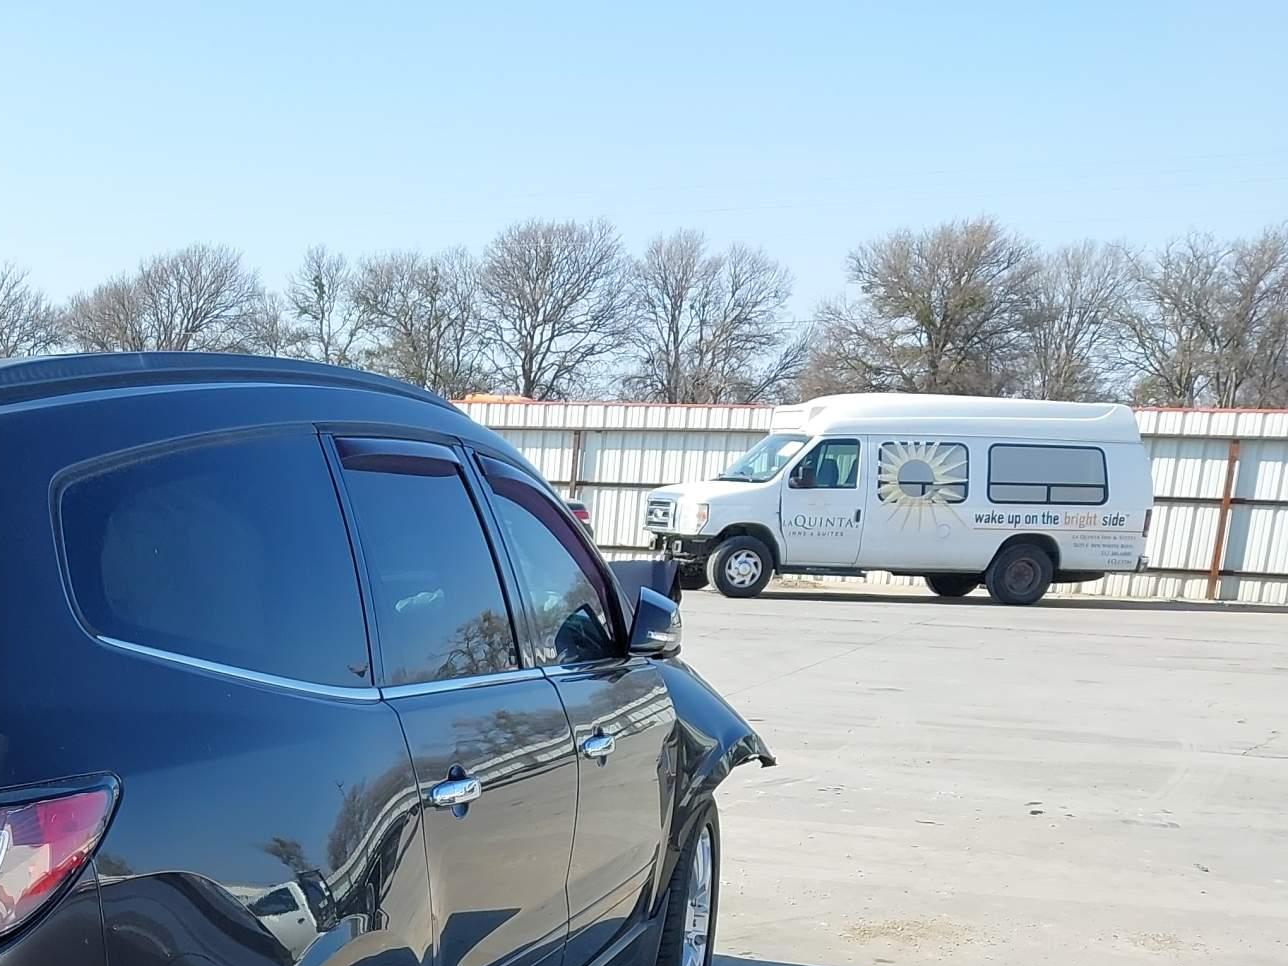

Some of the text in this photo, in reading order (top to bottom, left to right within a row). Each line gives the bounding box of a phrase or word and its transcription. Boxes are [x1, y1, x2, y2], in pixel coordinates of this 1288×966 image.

[794, 514, 853, 530] QUINTA
[975, 510, 1004, 524] wake
[1008, 513, 1021, 528] up
[1025, 514, 1038, 525] on
[1041, 511, 1060, 525] the
[1064, 512, 1097, 528] bright
